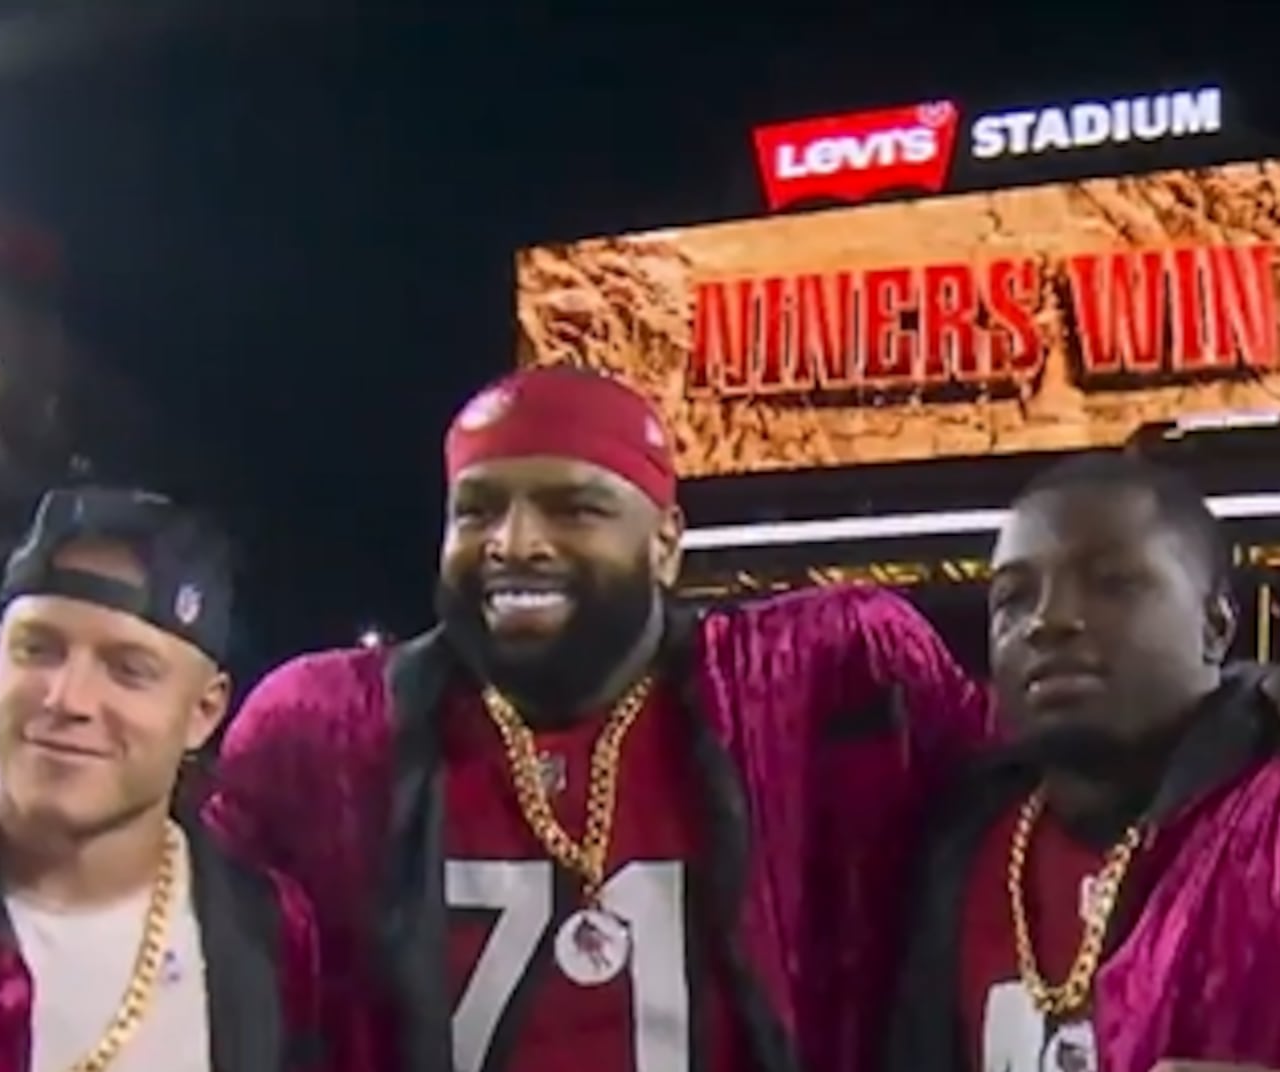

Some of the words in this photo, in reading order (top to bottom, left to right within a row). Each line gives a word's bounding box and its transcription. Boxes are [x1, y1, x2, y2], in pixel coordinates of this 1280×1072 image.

[971, 87, 1221, 159] STADIUM
[686, 258, 1049, 398] NINERS
[1064, 244, 1280, 386] WIN
